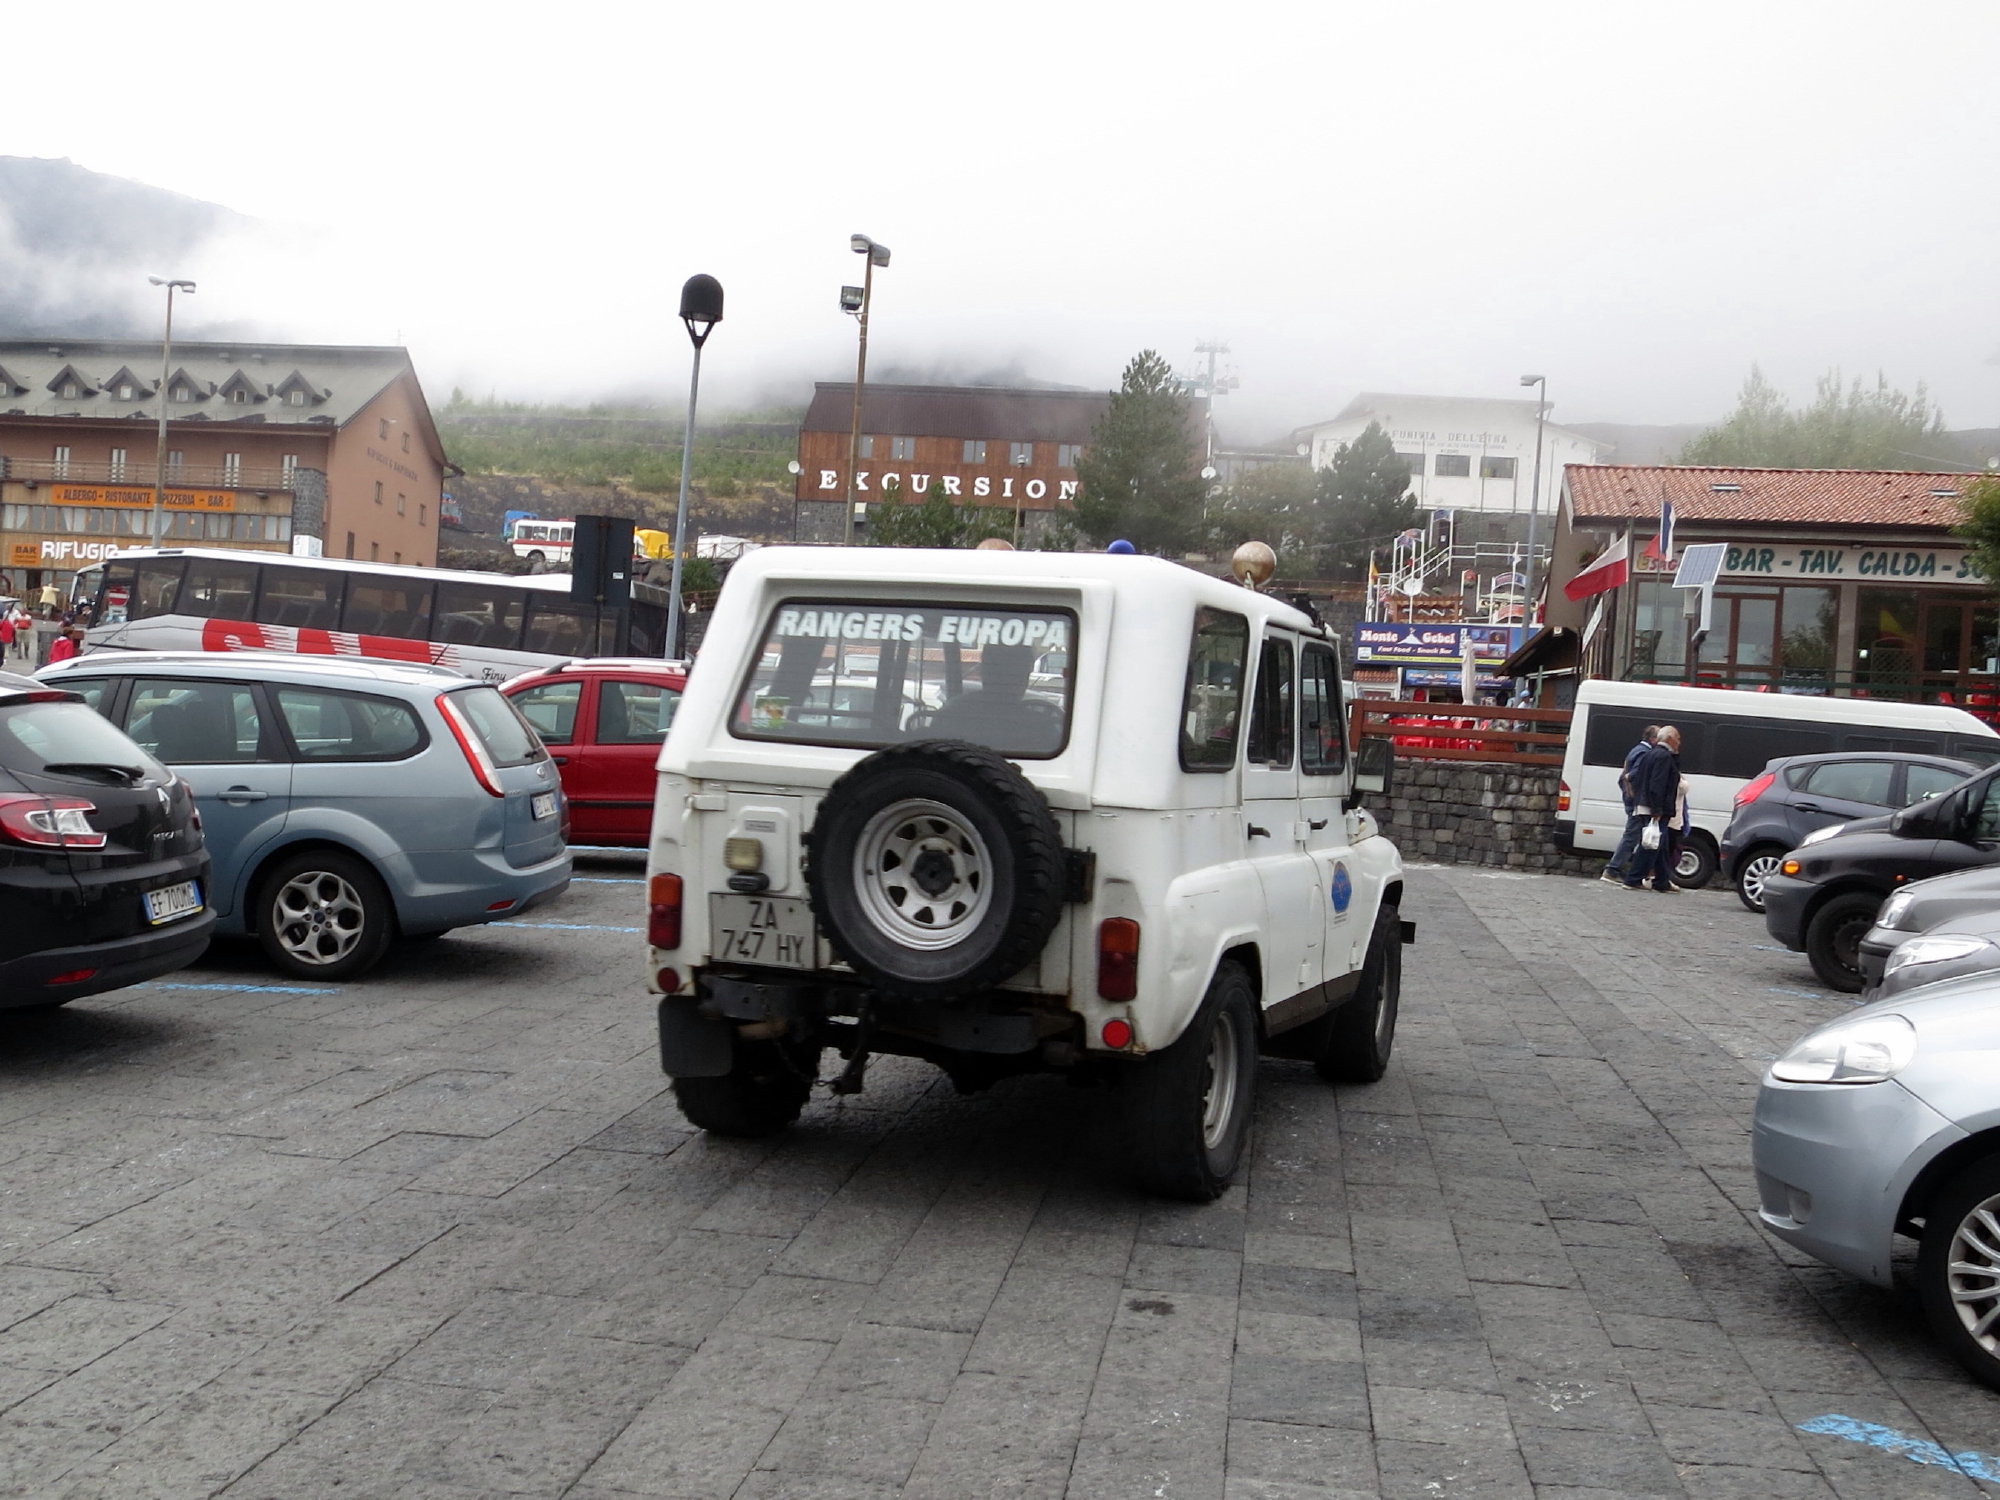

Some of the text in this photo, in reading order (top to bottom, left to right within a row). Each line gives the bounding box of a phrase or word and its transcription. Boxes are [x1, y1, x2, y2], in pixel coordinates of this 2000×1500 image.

[63, 489, 97, 502] ALBERGO
[105, 491, 151, 504] RISTORANTE
[1725, 547, 1775, 573] BAR
[1799, 549, 1844, 575] TAV.
[1858, 551, 1936, 577] CALDA
[777, 611, 1066, 647] RANGERS EUROPA
[1360, 630, 1398, 643] Monte
[1422, 632, 1456, 645] Gebel
[750, 901, 777, 929] ZA
[723, 929, 804, 962] 747 HY
